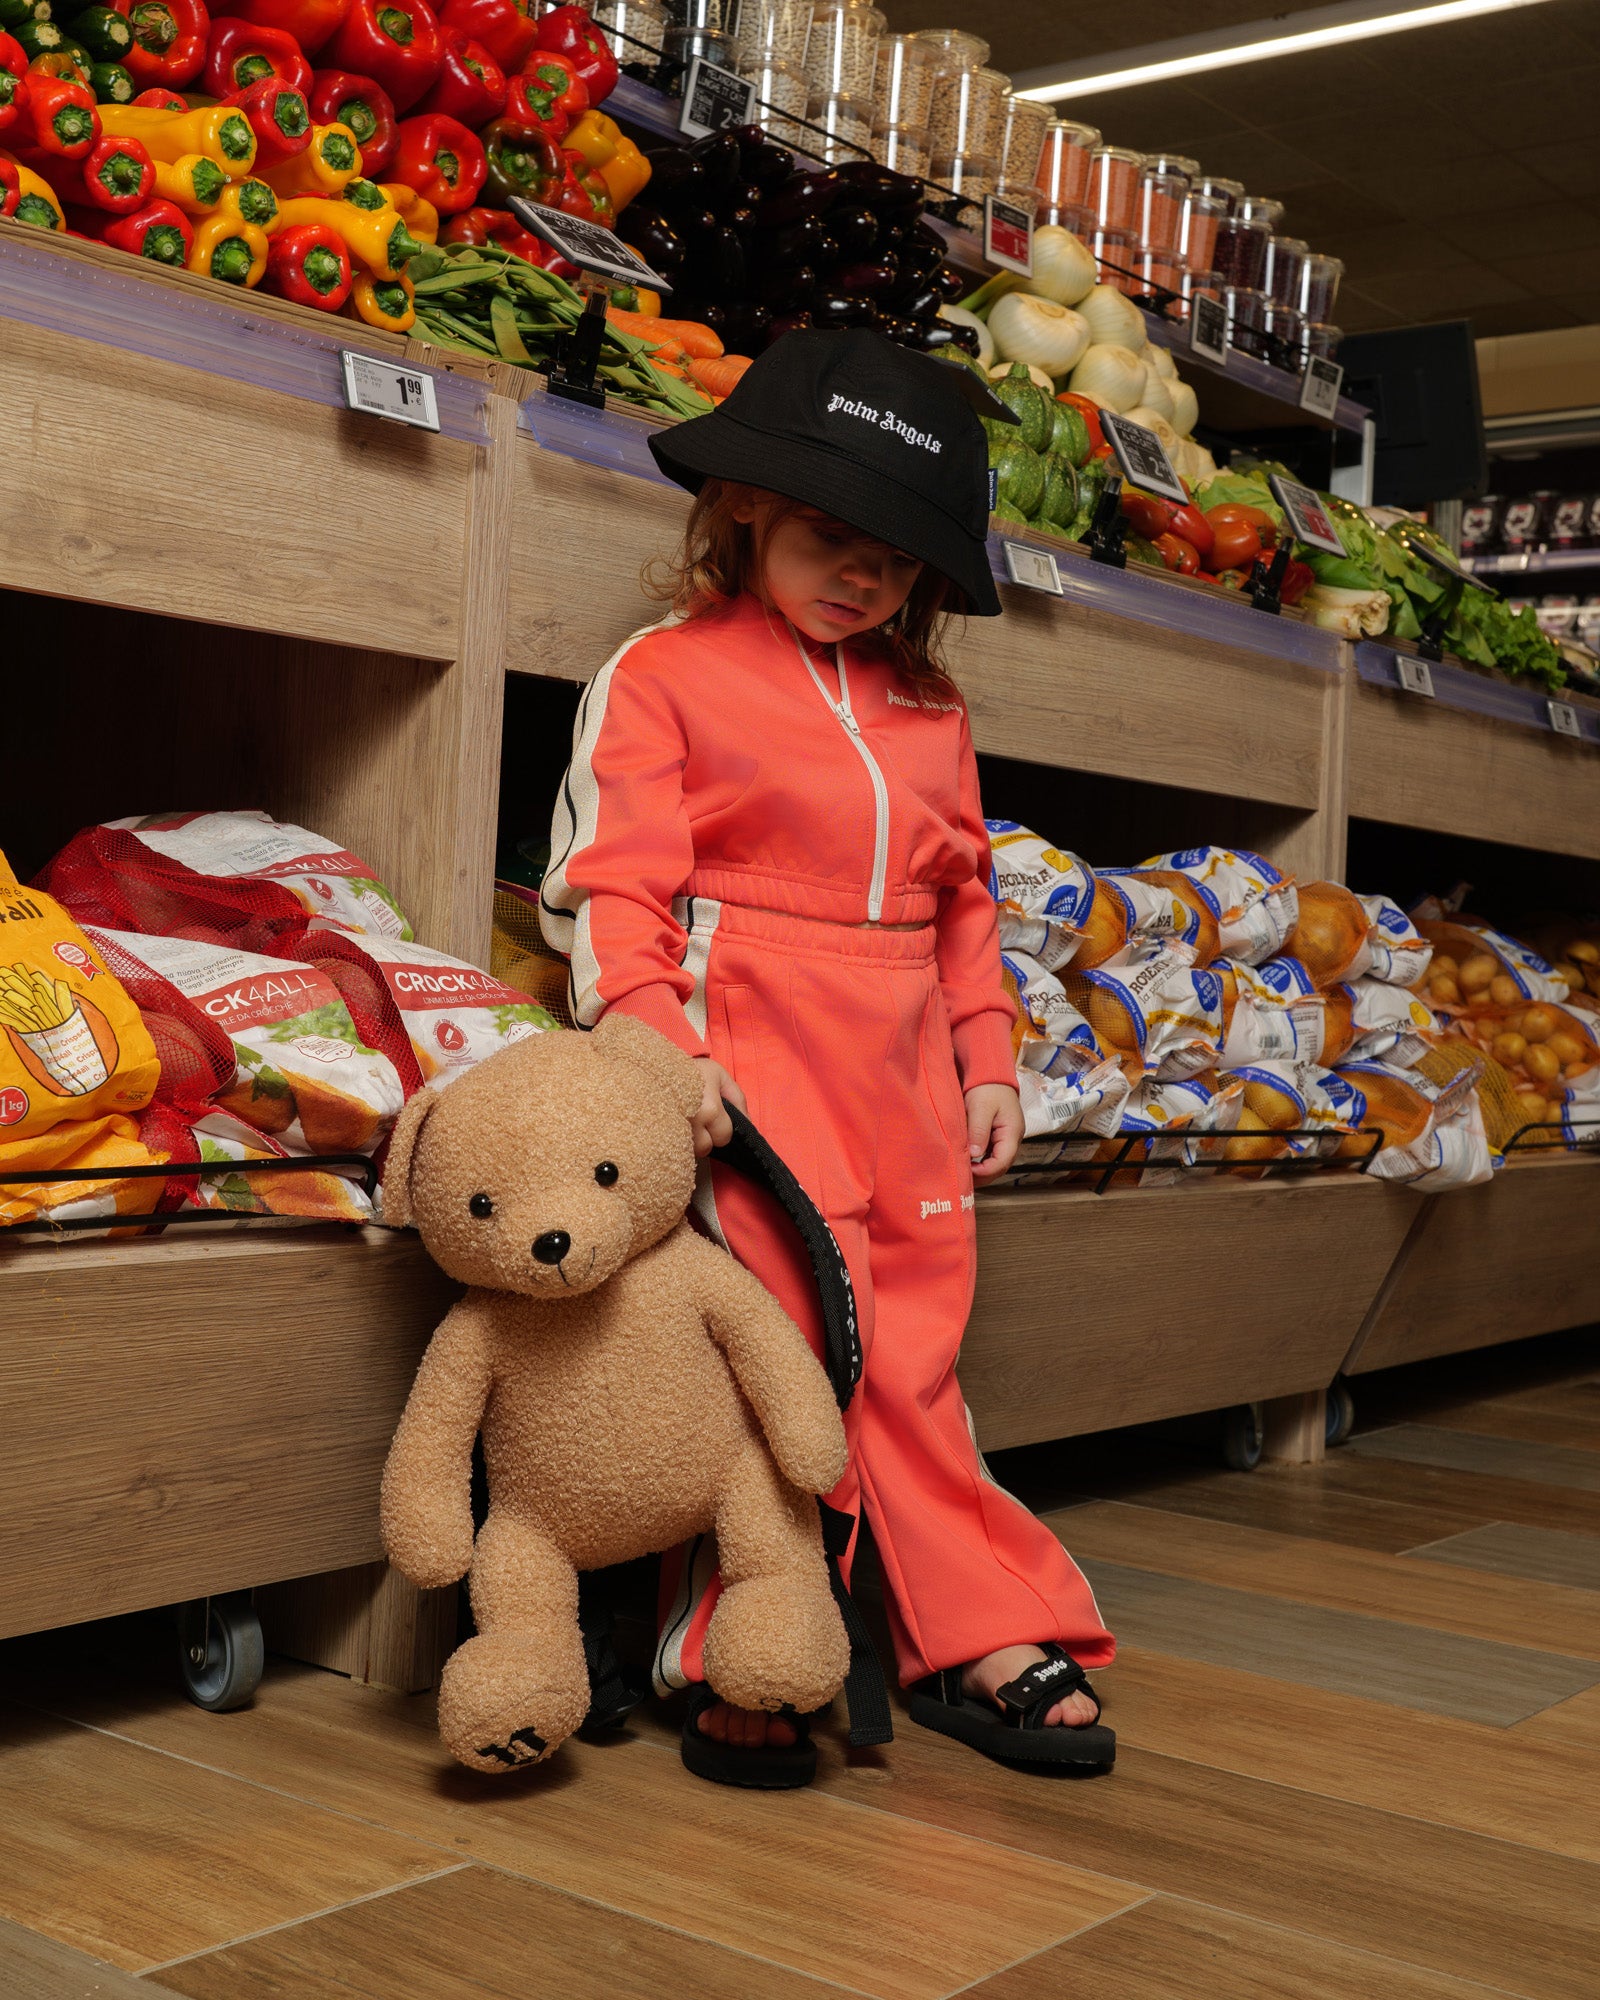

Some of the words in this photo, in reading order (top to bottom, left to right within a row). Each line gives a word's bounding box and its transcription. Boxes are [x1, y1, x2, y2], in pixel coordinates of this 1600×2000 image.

[827, 393, 879, 423] Palm
[880, 410, 942, 454] Angels
[203, 954, 244, 971] confezione
[217, 959, 245, 973] sempre
[238, 1012, 251, 1022] DA
[8, 1100, 24, 1111] kg
[920, 1198, 952, 1220] Palm
[1033, 1660, 1068, 1682] Angels
